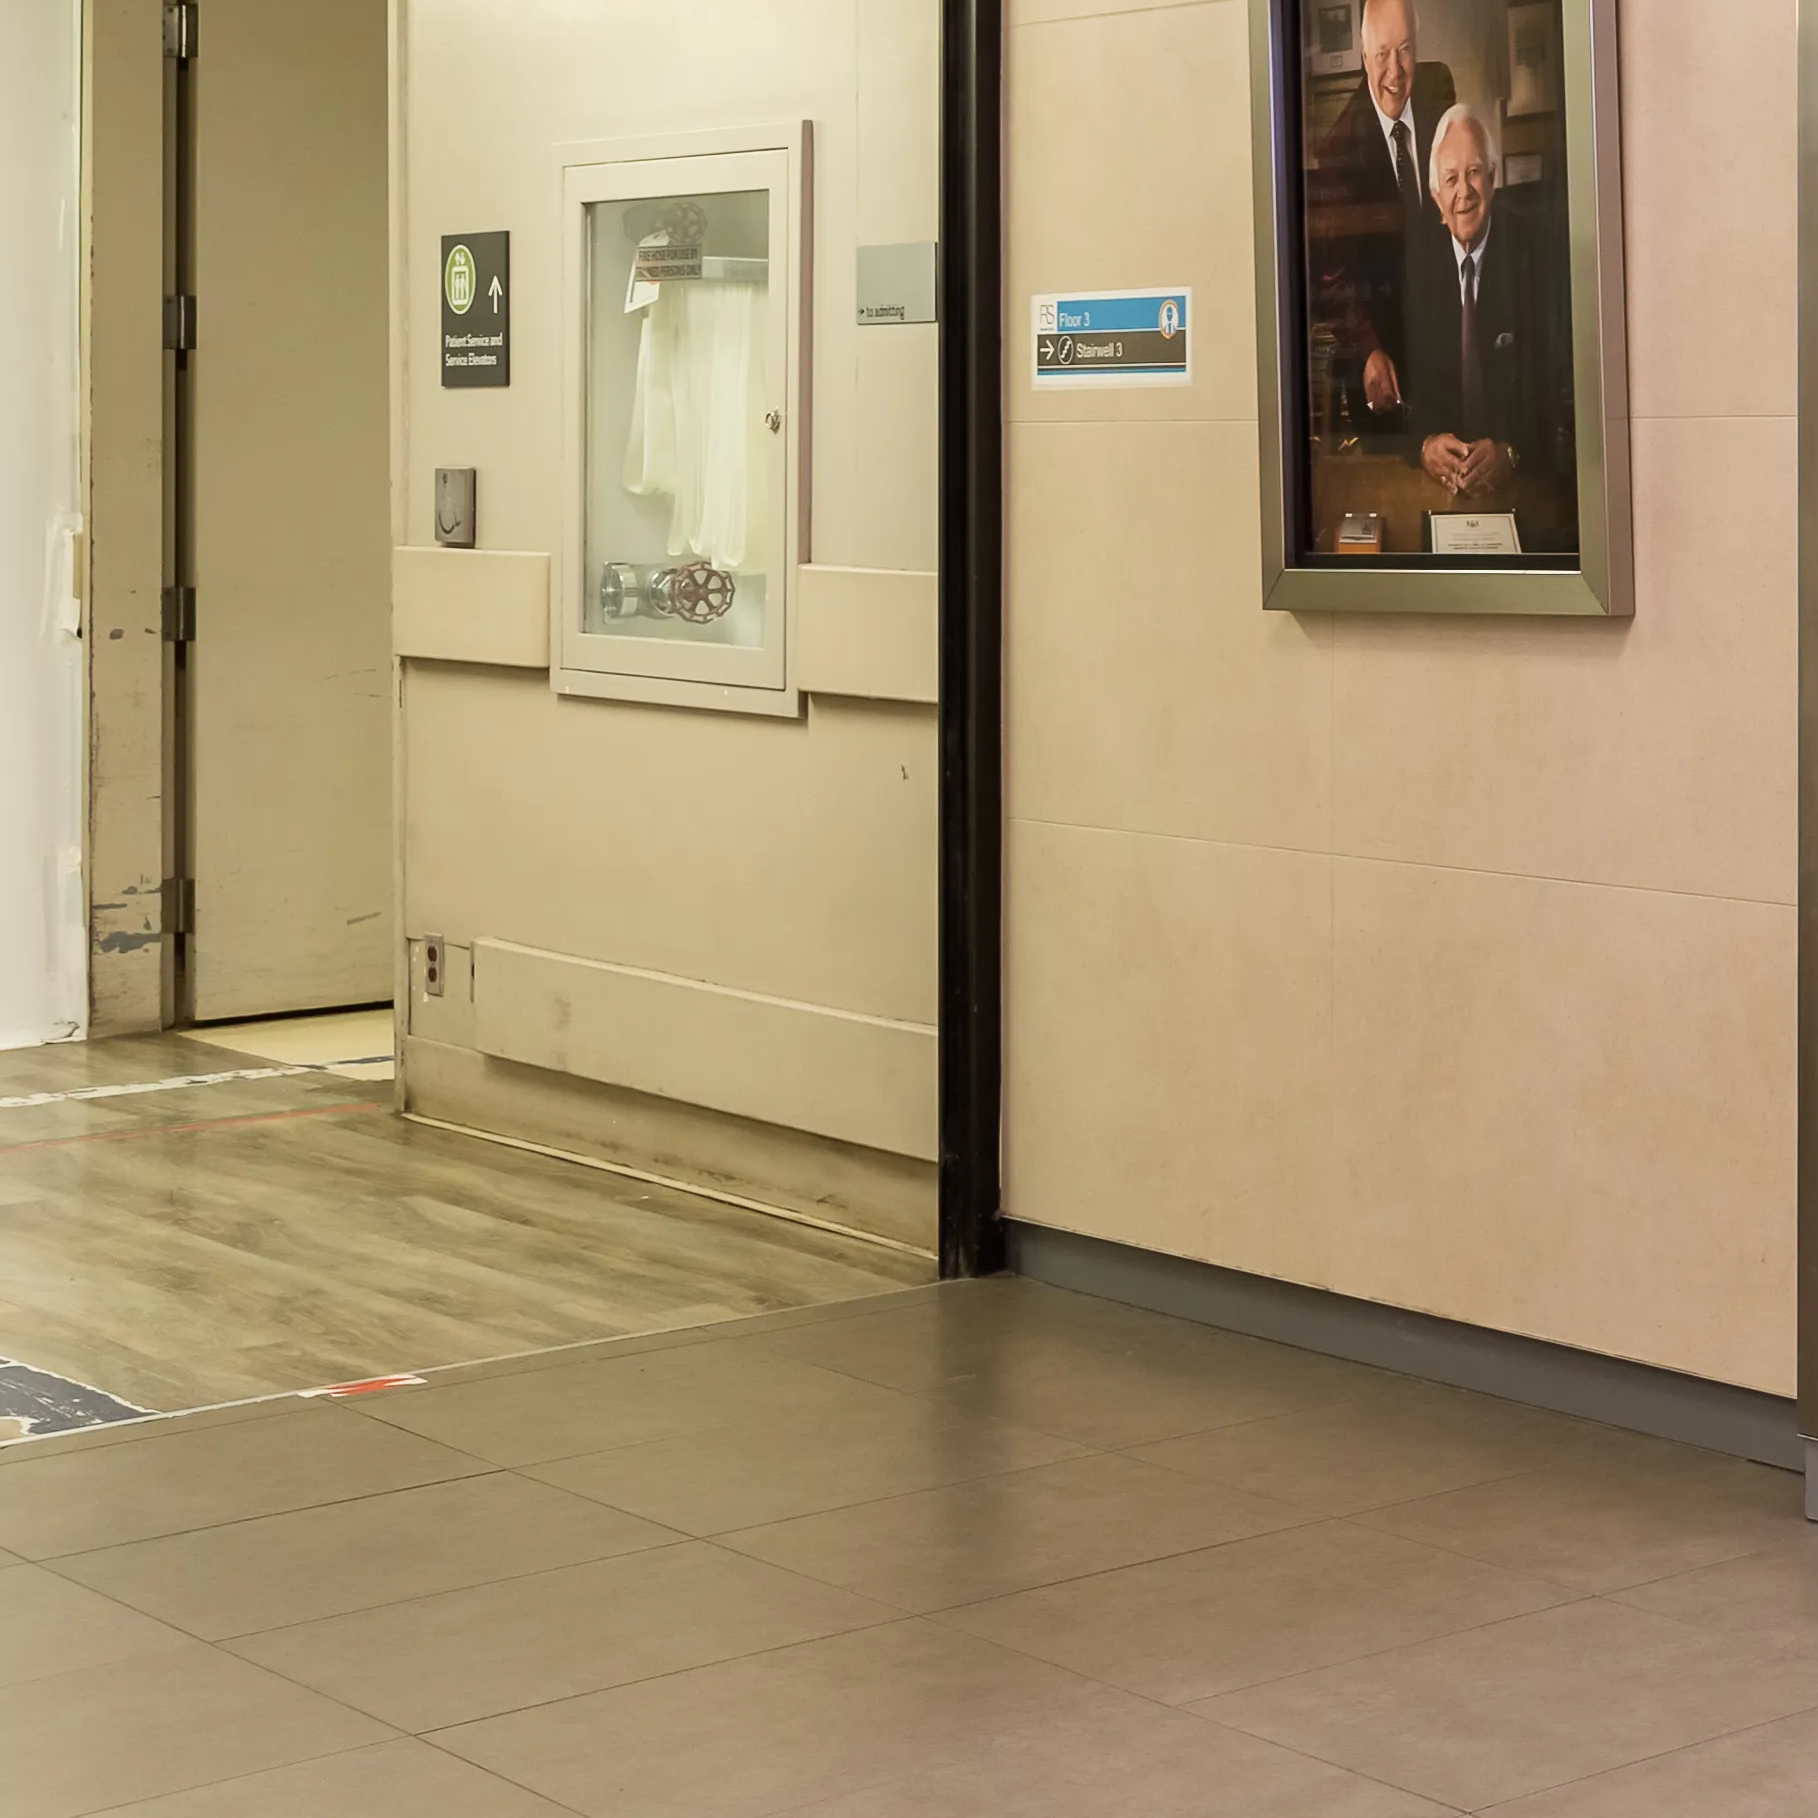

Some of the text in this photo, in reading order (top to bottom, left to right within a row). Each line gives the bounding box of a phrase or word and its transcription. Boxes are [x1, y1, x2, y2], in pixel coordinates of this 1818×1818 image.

[1059, 312, 1091, 327] Floor 3
[1076, 342, 1123, 358] Stairwell 3
